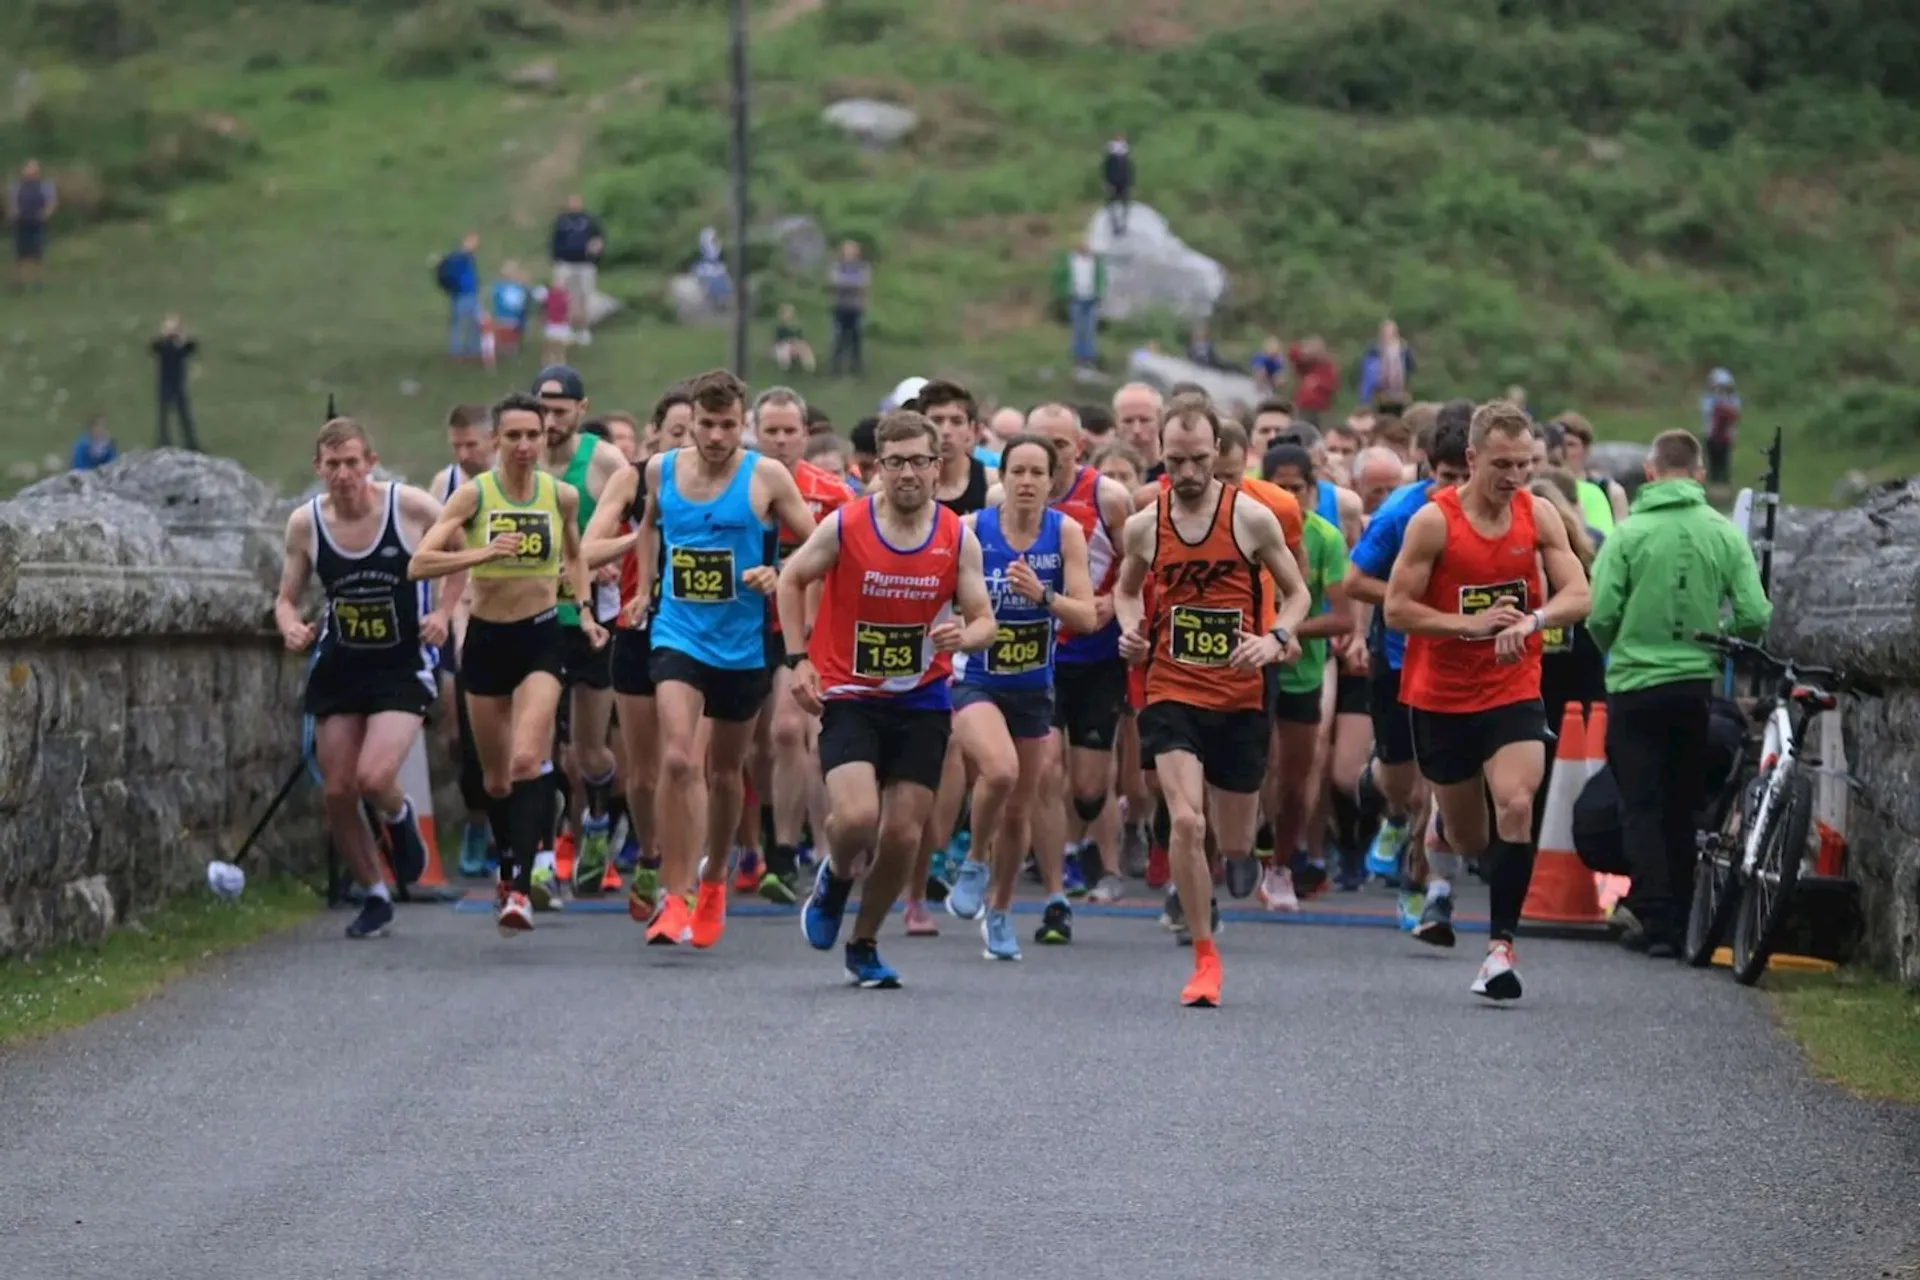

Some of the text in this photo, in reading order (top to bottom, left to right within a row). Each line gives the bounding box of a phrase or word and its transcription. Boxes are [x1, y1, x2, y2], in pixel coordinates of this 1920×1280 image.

[682, 570, 723, 592] 132
[864, 569, 940, 588] Plymouth
[862, 583, 937, 600] Harriers
[347, 617, 387, 639] 715
[998, 640, 1039, 663] 409
[1184, 631, 1229, 655] 193
[868, 645, 913, 668] 153
